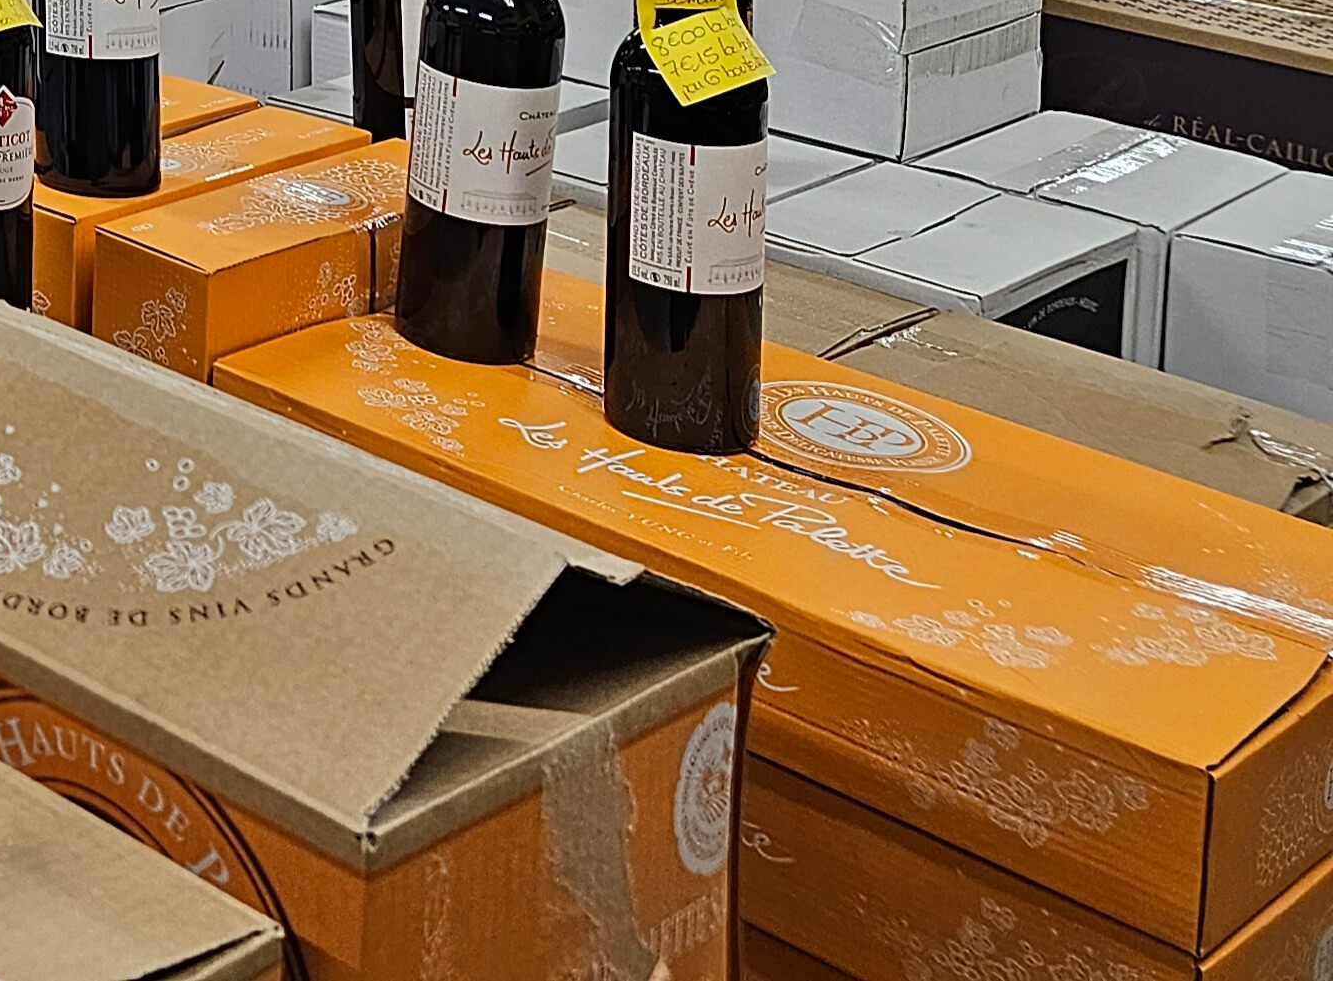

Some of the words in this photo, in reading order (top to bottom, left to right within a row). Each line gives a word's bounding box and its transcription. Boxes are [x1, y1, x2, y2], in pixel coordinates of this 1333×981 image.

[464, 130, 493, 162] Les
[708, 198, 737, 233] Les
[888, 405, 914, 421] DE
[498, 415, 568, 452] Les
[577, 448, 692, 497] Hauts
[691, 495, 744, 515] de
[739, 493, 941, 588] Palette
[263, 539, 396, 608] GRANDS
[106, 606, 149, 628] DE
[167, 594, 252, 626] VINS
[136, 777, 189, 846] DE
